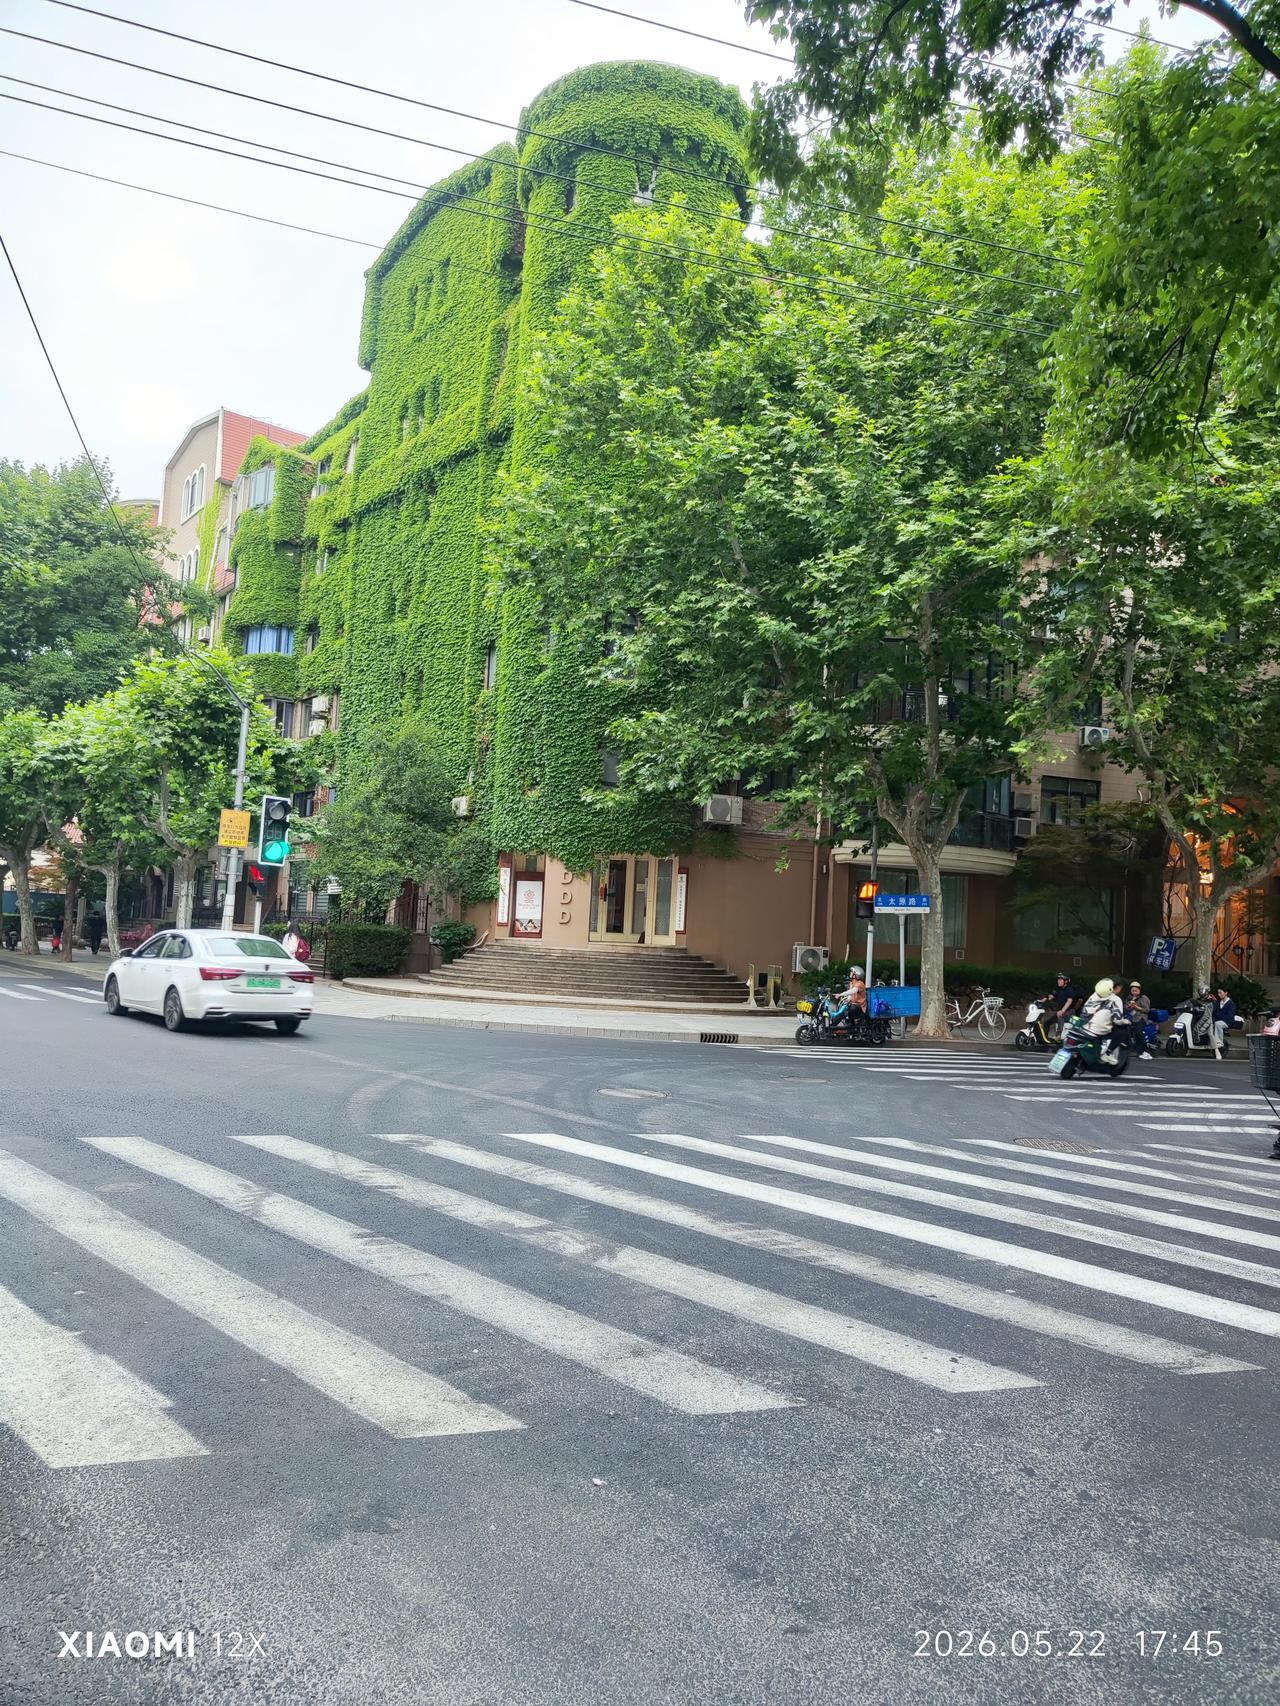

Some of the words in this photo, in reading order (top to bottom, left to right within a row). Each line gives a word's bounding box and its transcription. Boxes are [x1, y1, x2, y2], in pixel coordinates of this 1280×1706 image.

[888, 897, 916, 906] 太原路
[1152, 938, 1165, 954] P
